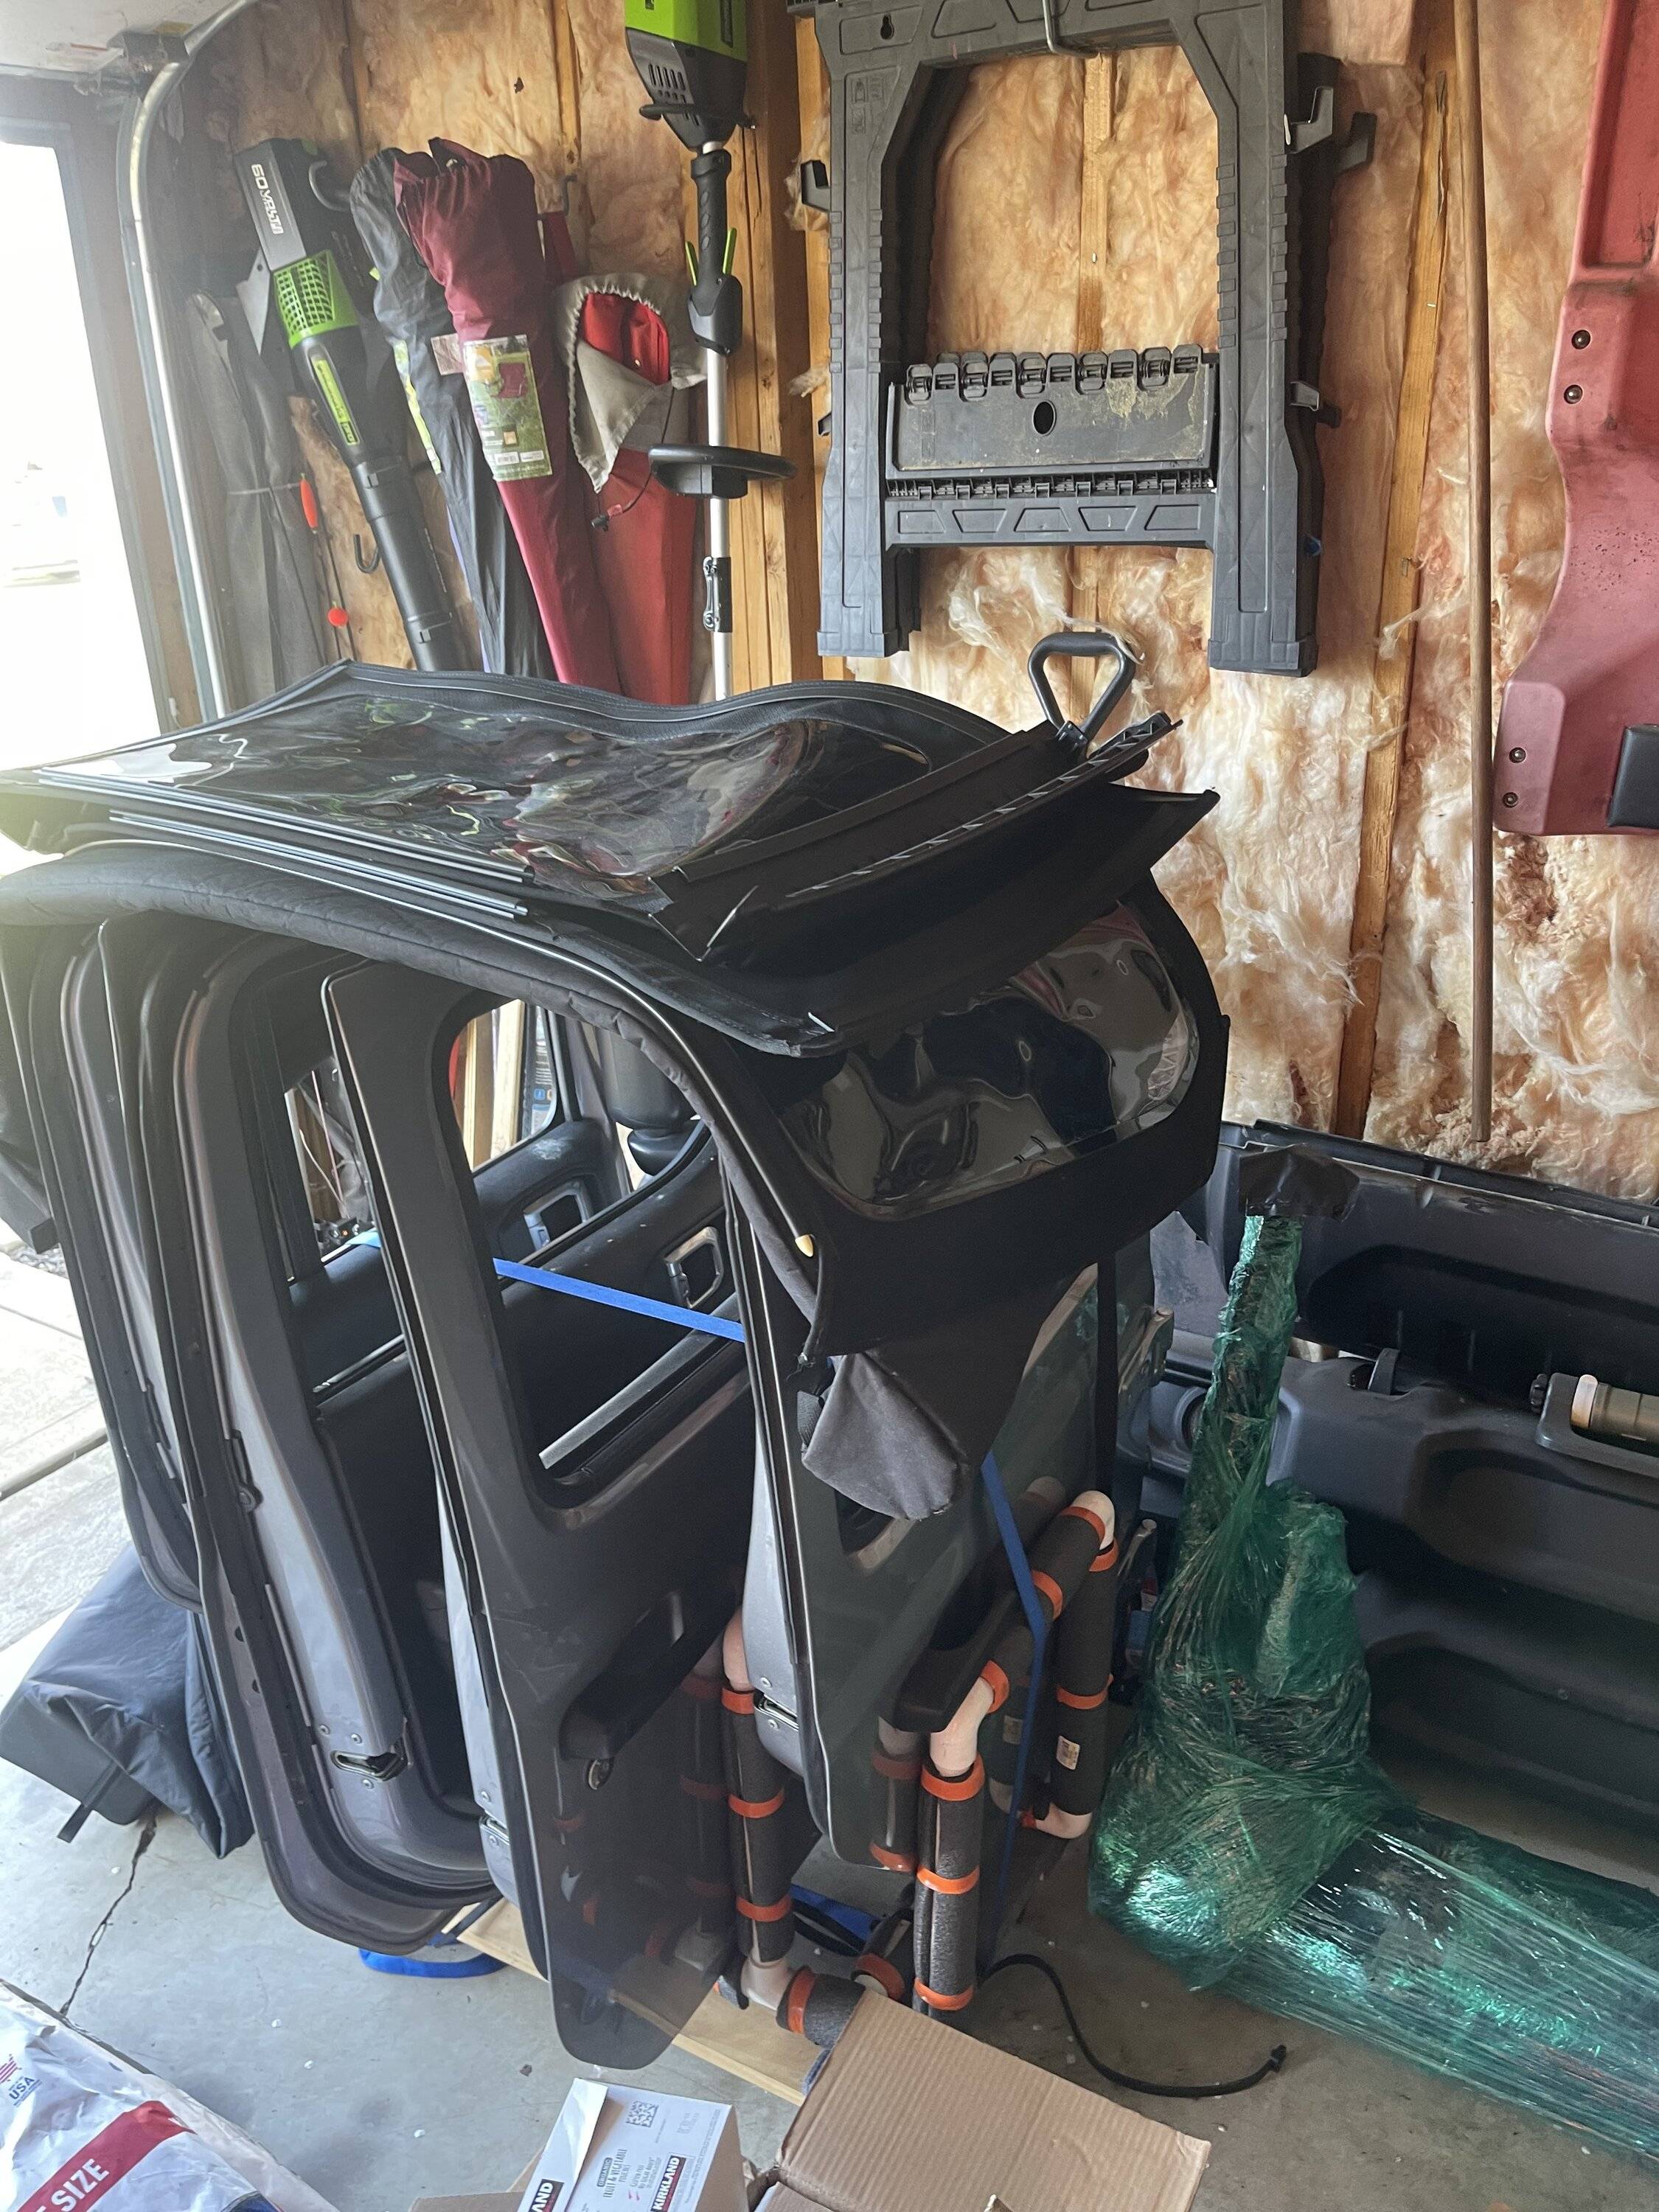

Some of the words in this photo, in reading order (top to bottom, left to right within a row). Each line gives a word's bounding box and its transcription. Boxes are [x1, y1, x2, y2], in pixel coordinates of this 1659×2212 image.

[9, 2076, 35, 2100] USA
[51, 2158, 109, 2212] SIZE
[652, 2157, 680, 2211] KIRKLAND
